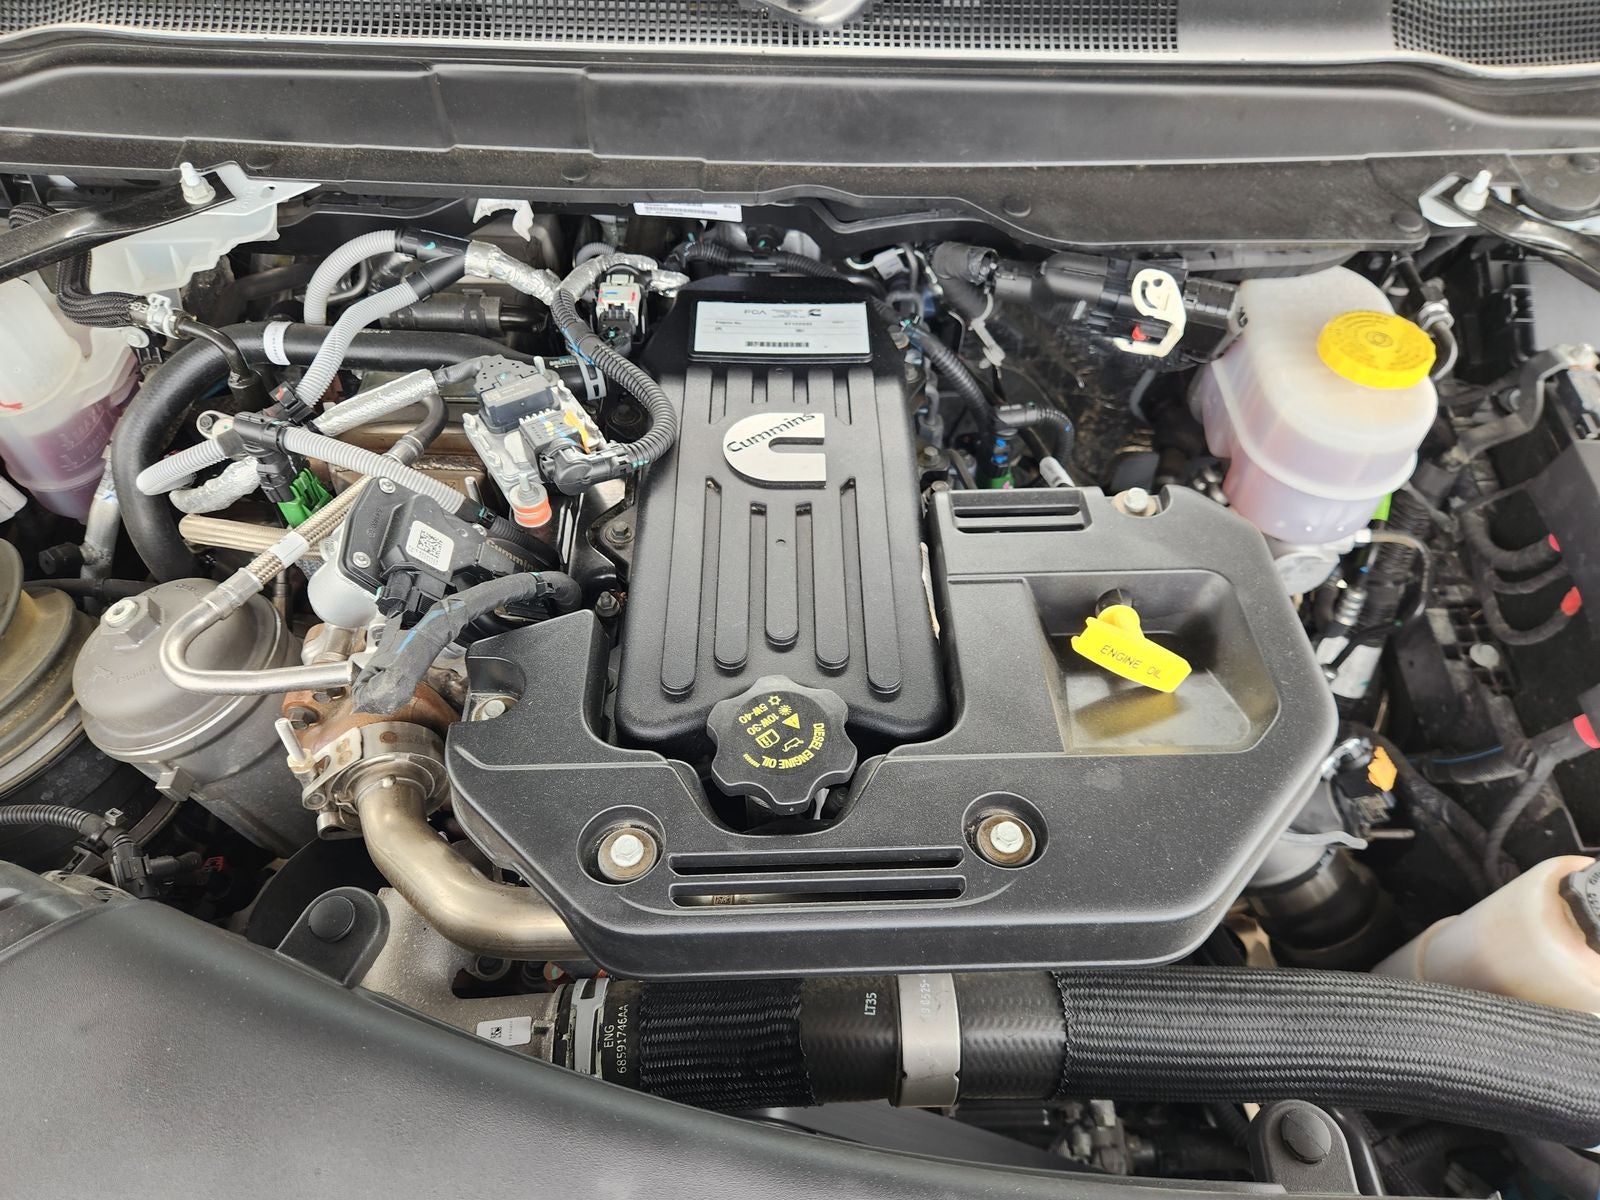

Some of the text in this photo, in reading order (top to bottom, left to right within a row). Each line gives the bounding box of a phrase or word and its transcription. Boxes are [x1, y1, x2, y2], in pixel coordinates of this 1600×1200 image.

[726, 413, 816, 453] Cummins
[1100, 644, 1161, 680] ENGINE OIL
[738, 703, 769, 724] 5W-40
[746, 712, 780, 735] 10W-30
[808, 722, 826, 750] DIESEL
[762, 755, 777, 769] OIL
[778, 749, 815, 769] ENGINE
[863, 992, 878, 1016] LT35
[603, 1024, 615, 1048] ENG
[616, 1003, 629, 1074] 68591746AA
